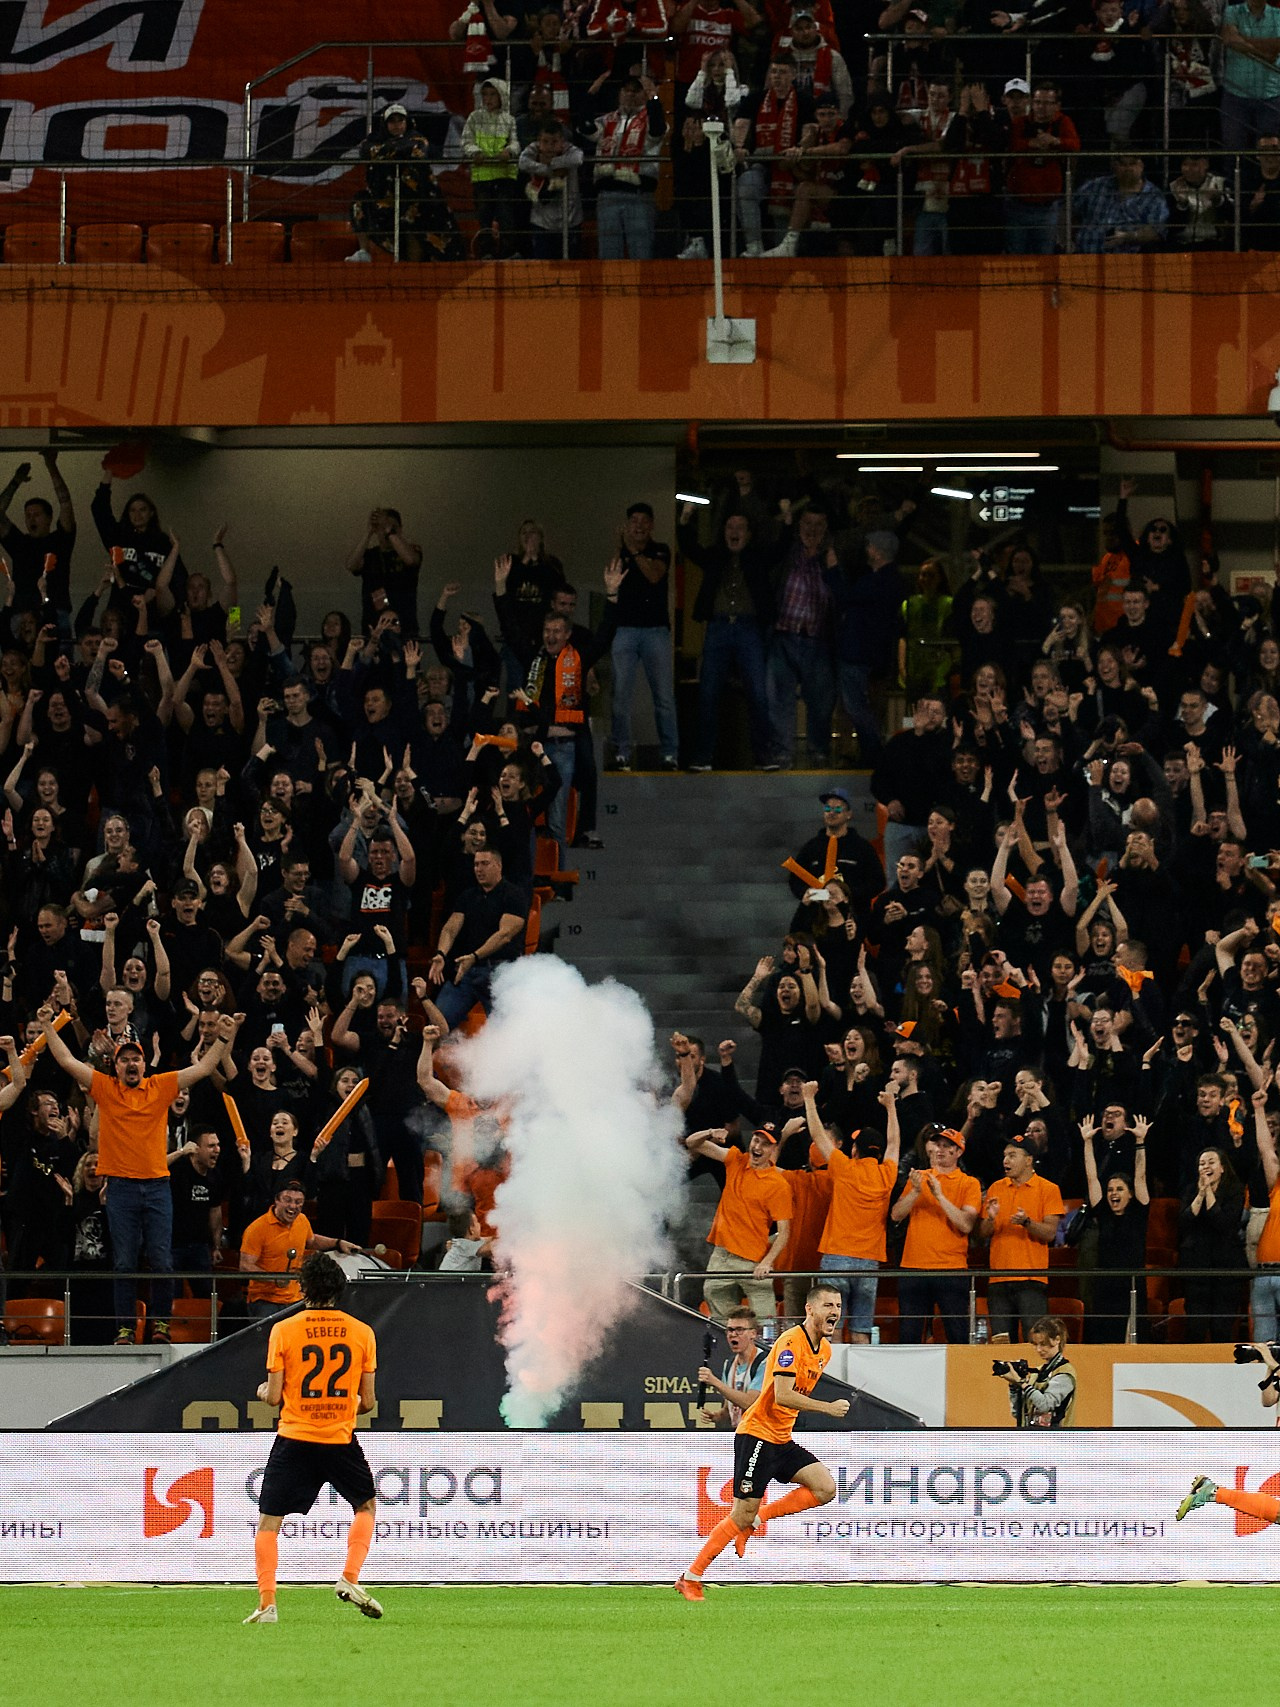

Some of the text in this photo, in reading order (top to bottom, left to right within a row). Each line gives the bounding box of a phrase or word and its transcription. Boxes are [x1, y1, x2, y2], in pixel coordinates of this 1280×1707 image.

[0, 76, 464, 194] ОЙ
[605, 804, 618, 814] 12
[568, 924, 581, 935] 10
[306, 1327, 347, 1339] БЕВЕЕВ
[301, 1343, 352, 1398] 22
[745, 1440, 764, 1478] BetBoom
[245, 1466, 502, 1517] сара
[247, 1520, 609, 1543] танспртные машины
[802, 1520, 1164, 1542] транспортные машины
